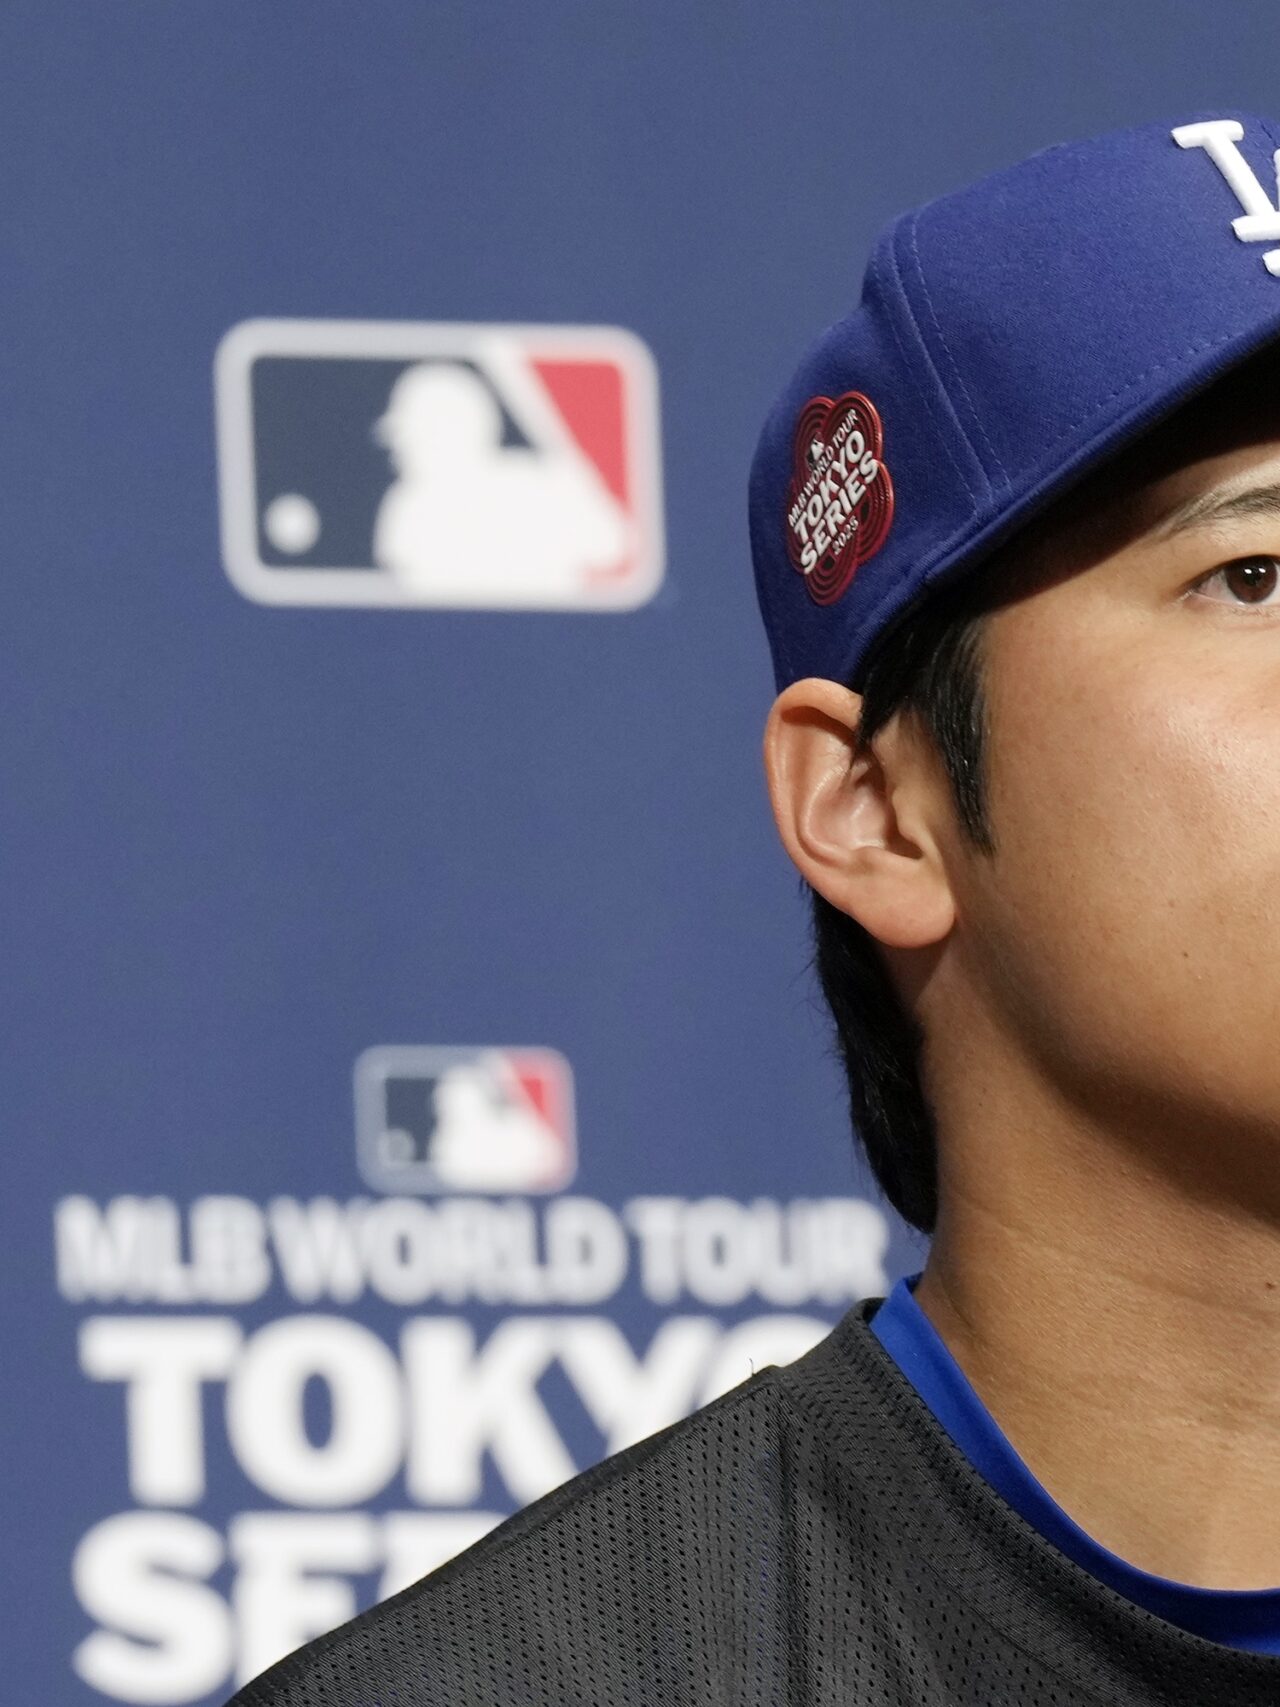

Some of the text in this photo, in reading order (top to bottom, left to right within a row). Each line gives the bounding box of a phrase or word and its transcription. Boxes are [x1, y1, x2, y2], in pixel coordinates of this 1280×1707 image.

[794, 430, 864, 544] TOKYO
[803, 446, 833, 497] WORLD
[832, 409, 859, 449] TOUR
[801, 451, 879, 574] SERIES
[832, 516, 859, 556] 2025
[54, 1195, 890, 1304] MLB WORLD TOUR
[78, 1315, 838, 1508] TOKY
